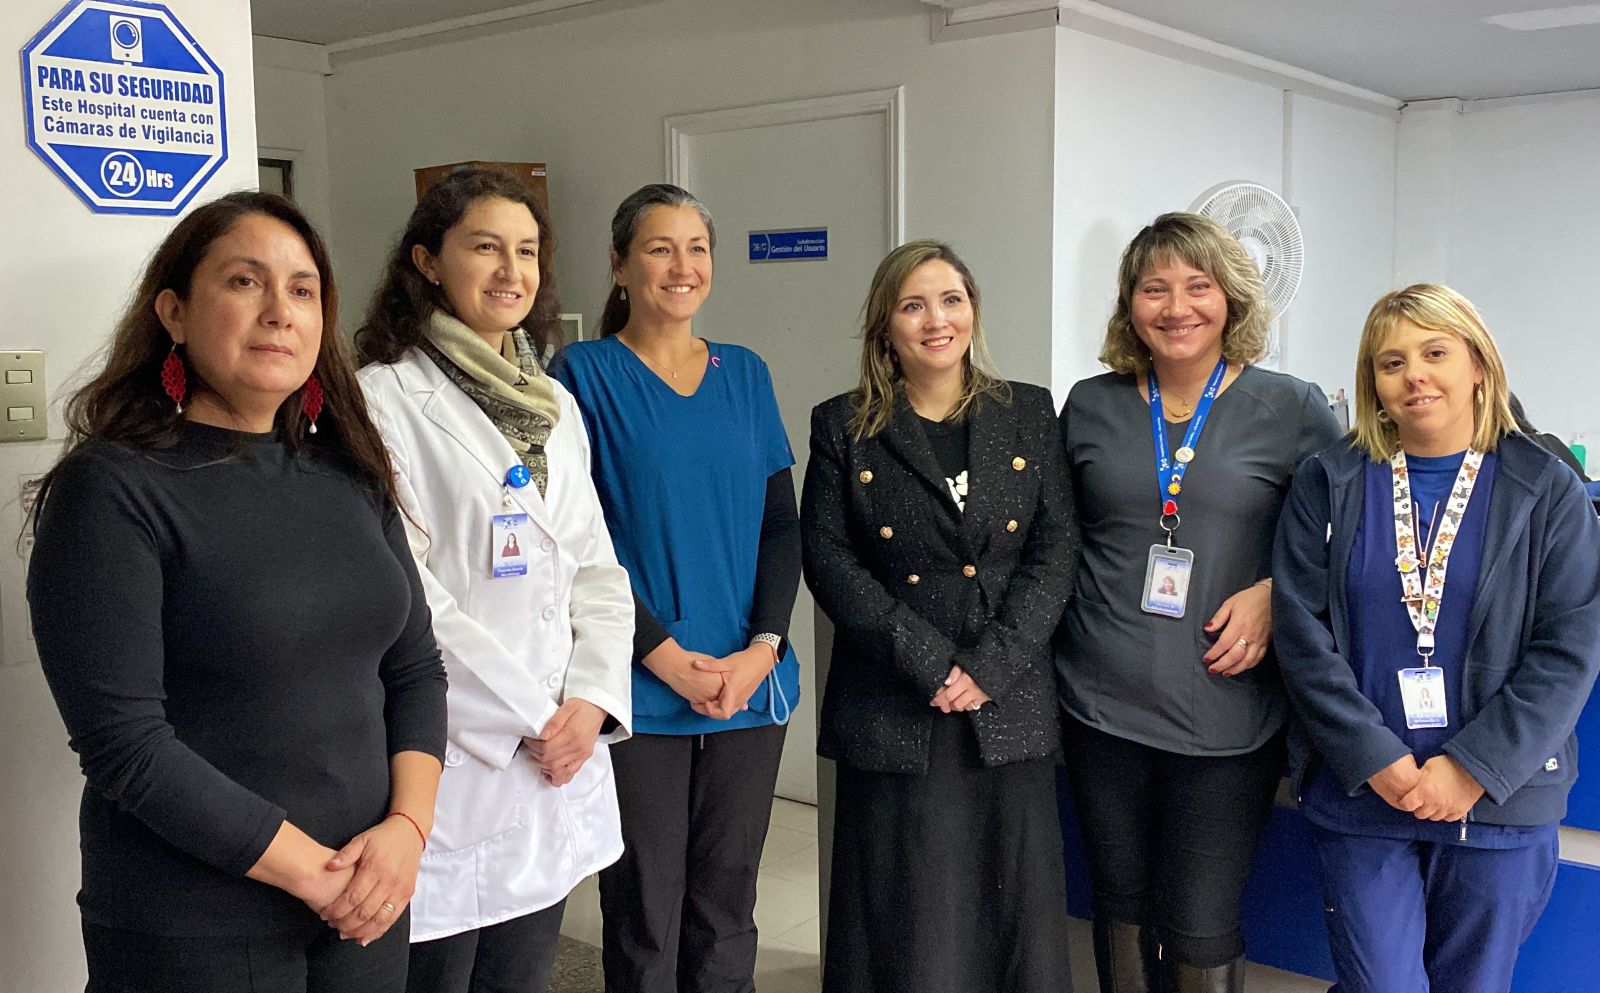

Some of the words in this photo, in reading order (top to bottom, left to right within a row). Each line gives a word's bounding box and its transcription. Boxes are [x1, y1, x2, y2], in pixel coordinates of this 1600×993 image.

[38, 66, 85, 92] PARA
[90, 72, 113, 95] SU
[118, 75, 214, 104] SEGURIDAD
[42, 96, 73, 112] Este
[78, 99, 136, 118] Hospital
[140, 108, 186, 123] cuenta
[191, 112, 214, 125] con
[44, 115, 114, 137] Cámaras
[119, 122, 137, 139] de
[142, 124, 214, 145] Vigilancia
[108, 160, 137, 187] 24
[146, 169, 174, 188] Hrs
[804, 244, 826, 252] Usuario
